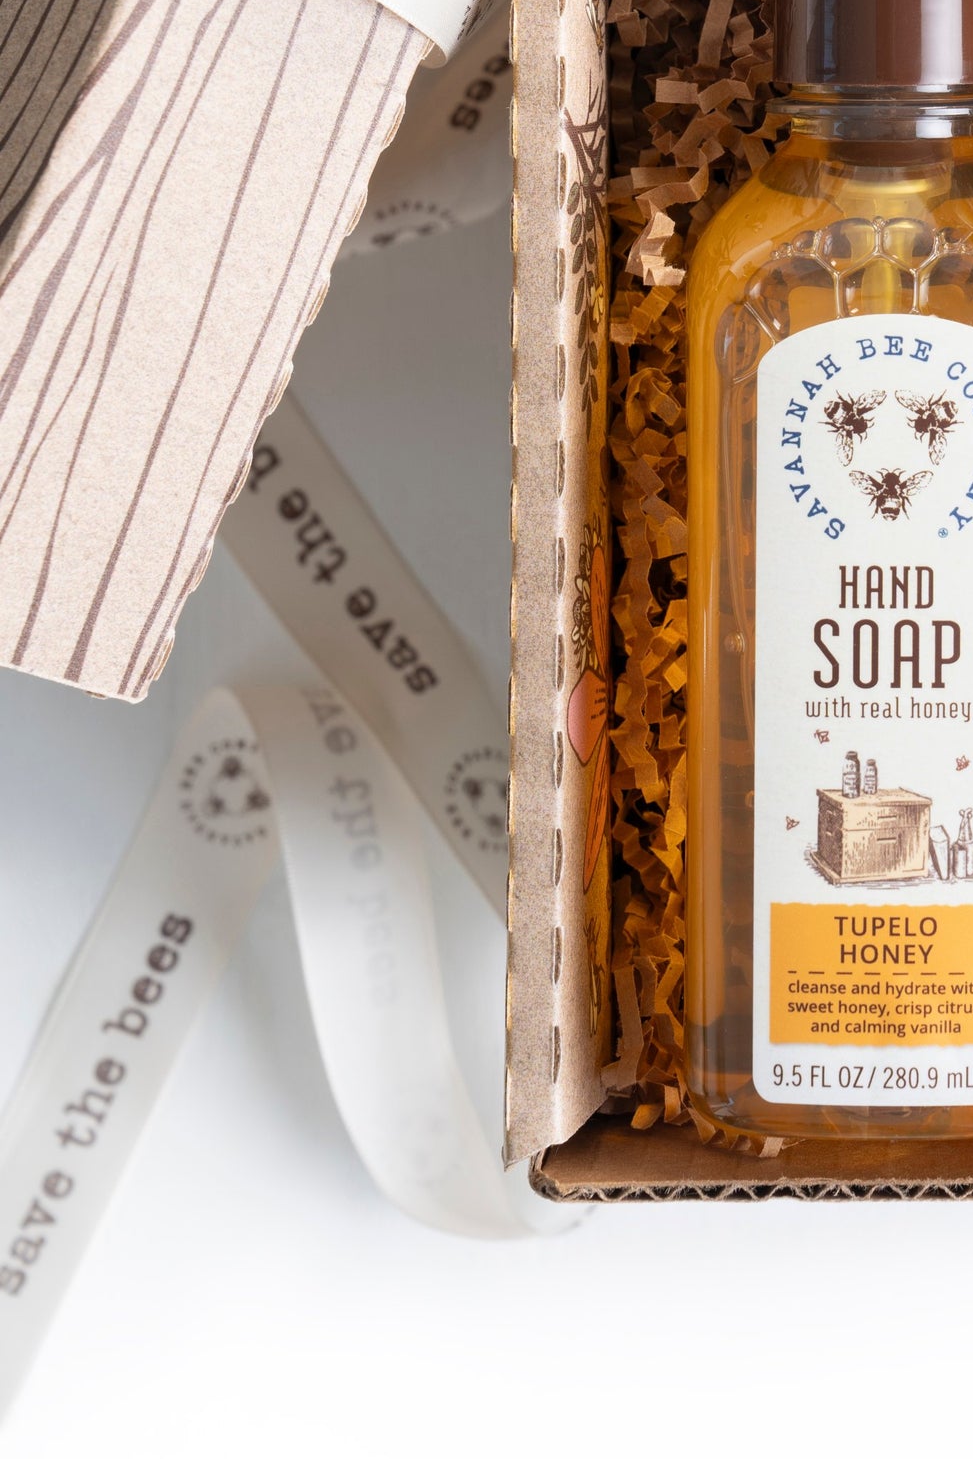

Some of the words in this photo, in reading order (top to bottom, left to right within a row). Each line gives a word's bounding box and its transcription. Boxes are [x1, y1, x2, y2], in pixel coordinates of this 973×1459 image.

[782, 354, 845, 540] SAVANNAH
[856, 335, 933, 363] BEE
[278, 487, 347, 585] the
[839, 565, 933, 609] HAND
[346, 586, 439, 694] save
[814, 619, 960, 689] SOAP
[806, 696, 850, 717] with
[861, 697, 901, 718] real
[911, 697, 971, 722] honey
[834, 917, 937, 936] TUPELO
[841, 944, 933, 964] HONEY
[789, 980, 846, 994] cleanse
[852, 982, 880, 994] and
[886, 982, 946, 999] hydrate
[788, 1002, 833, 1013] sweet
[839, 1000, 889, 1018] honey,
[895, 1001, 932, 1018] crisp
[811, 1020, 839, 1032] and
[845, 1020, 905, 1037] calming
[911, 1017, 961, 1034] vanilla
[773, 1064, 802, 1086] 9.5
[811, 1066, 831, 1087] FL
[883, 1067, 938, 1089] 280.9
[0, 1169, 75, 1297] save
[55, 1056, 127, 1149] the
[102, 911, 195, 1039] bees
